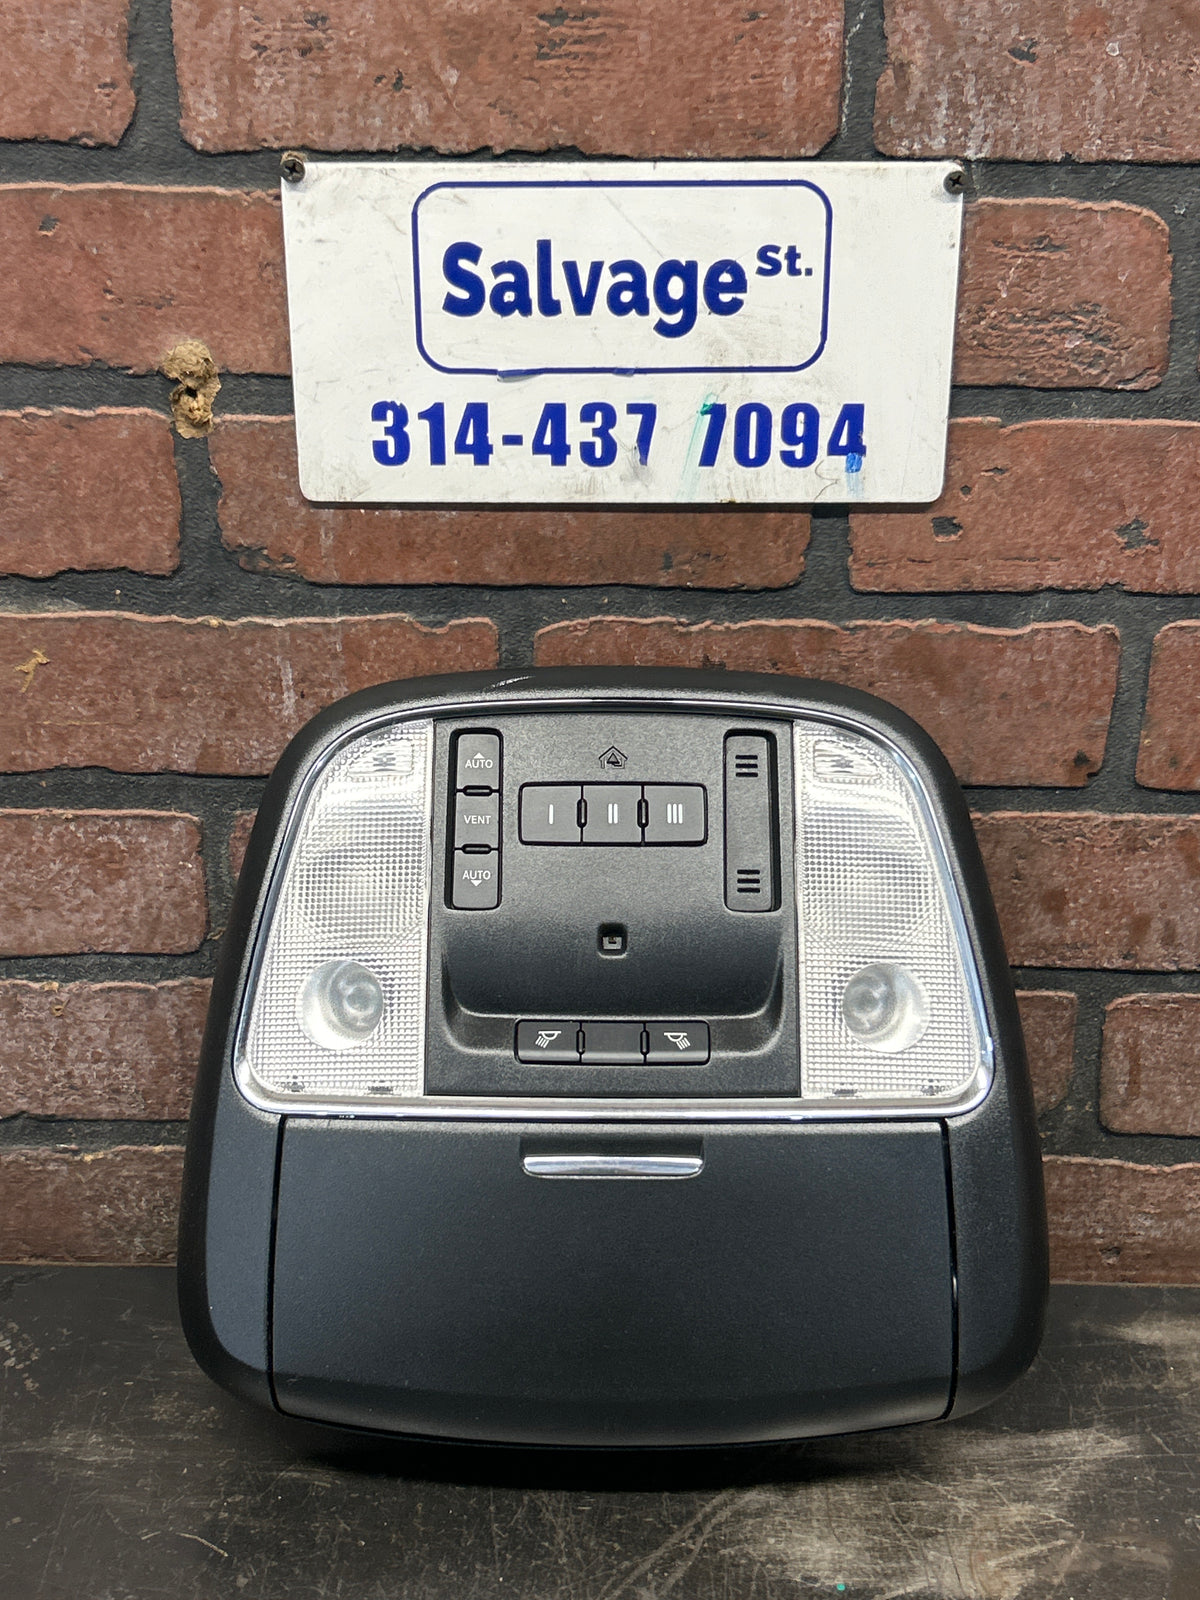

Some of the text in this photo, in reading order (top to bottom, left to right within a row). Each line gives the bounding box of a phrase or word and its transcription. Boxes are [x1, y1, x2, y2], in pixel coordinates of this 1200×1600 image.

[441, 239, 813, 339] Salvage St.
[699, 401, 867, 471] 7094
[464, 758, 493, 769] AUTO
[463, 815, 492, 825] VENT
[462, 869, 491, 880] AUTO
